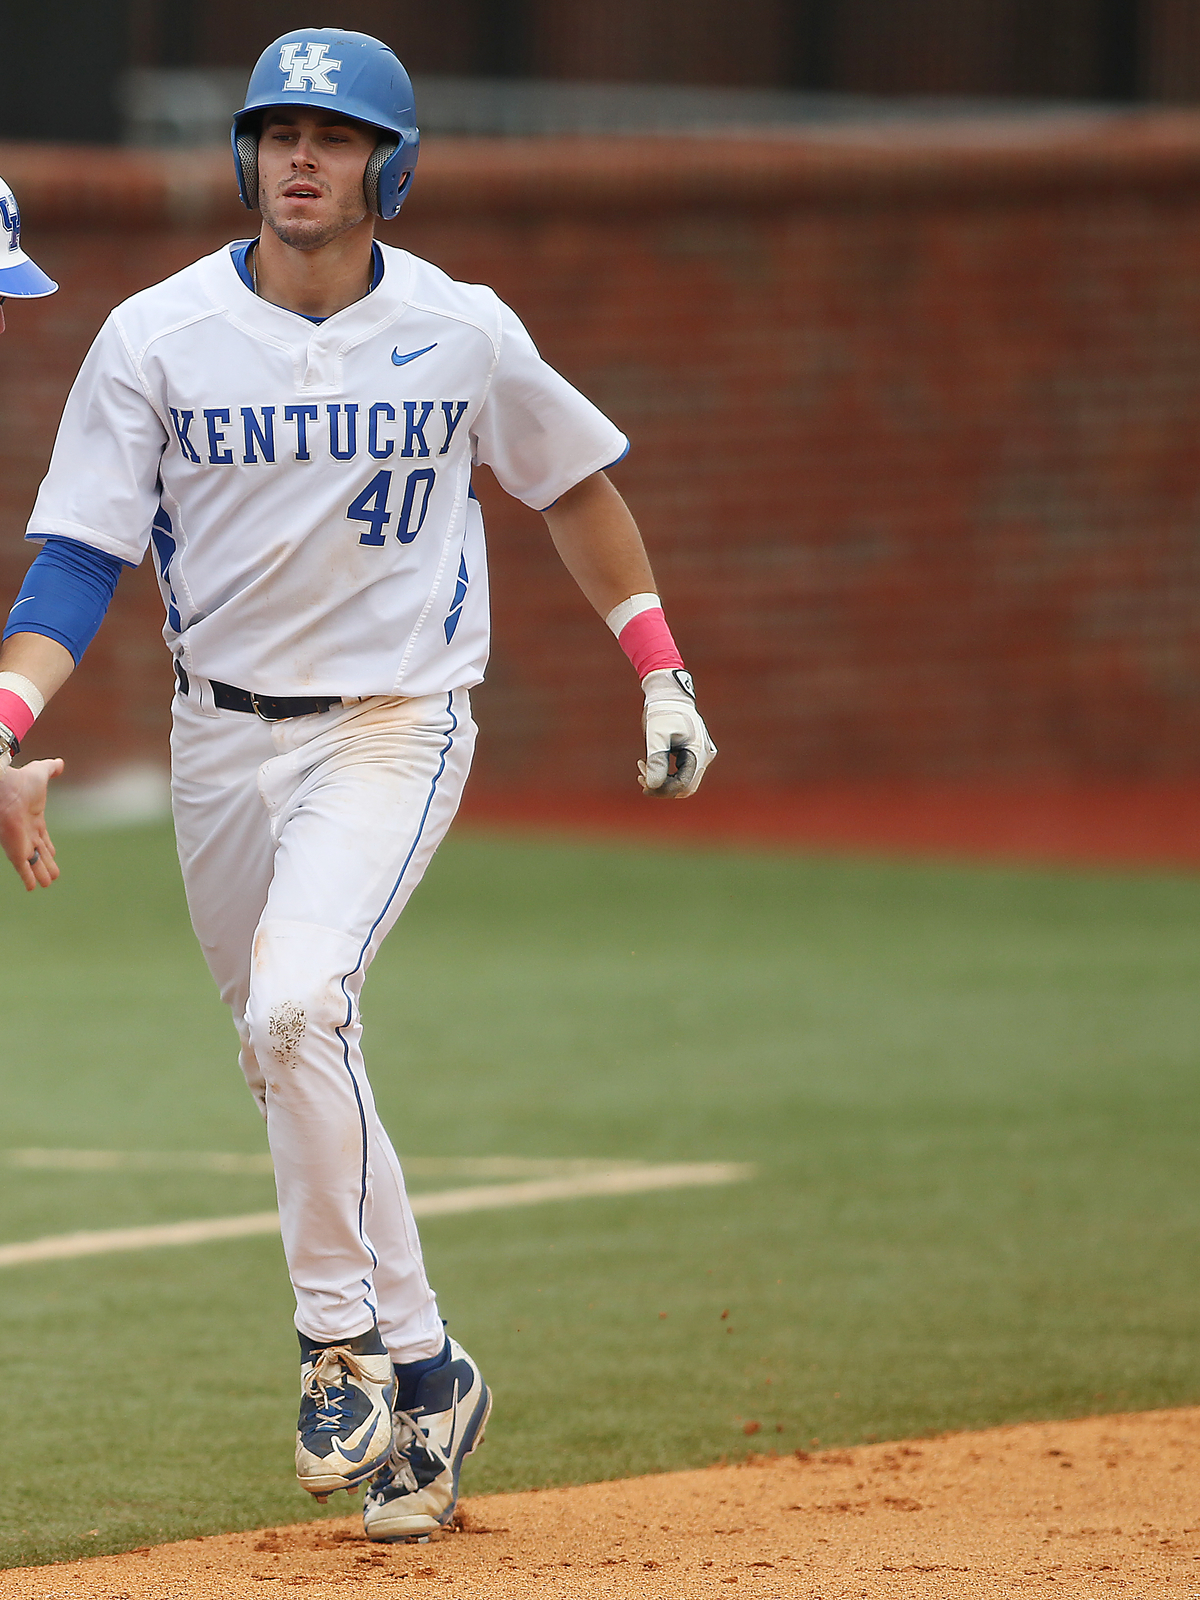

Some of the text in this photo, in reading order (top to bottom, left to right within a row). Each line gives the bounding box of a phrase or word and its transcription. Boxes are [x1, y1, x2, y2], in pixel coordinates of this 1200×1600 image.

[279, 42, 342, 95] UK
[168, 399, 469, 465] KENTUCKY
[344, 467, 437, 548] 40
